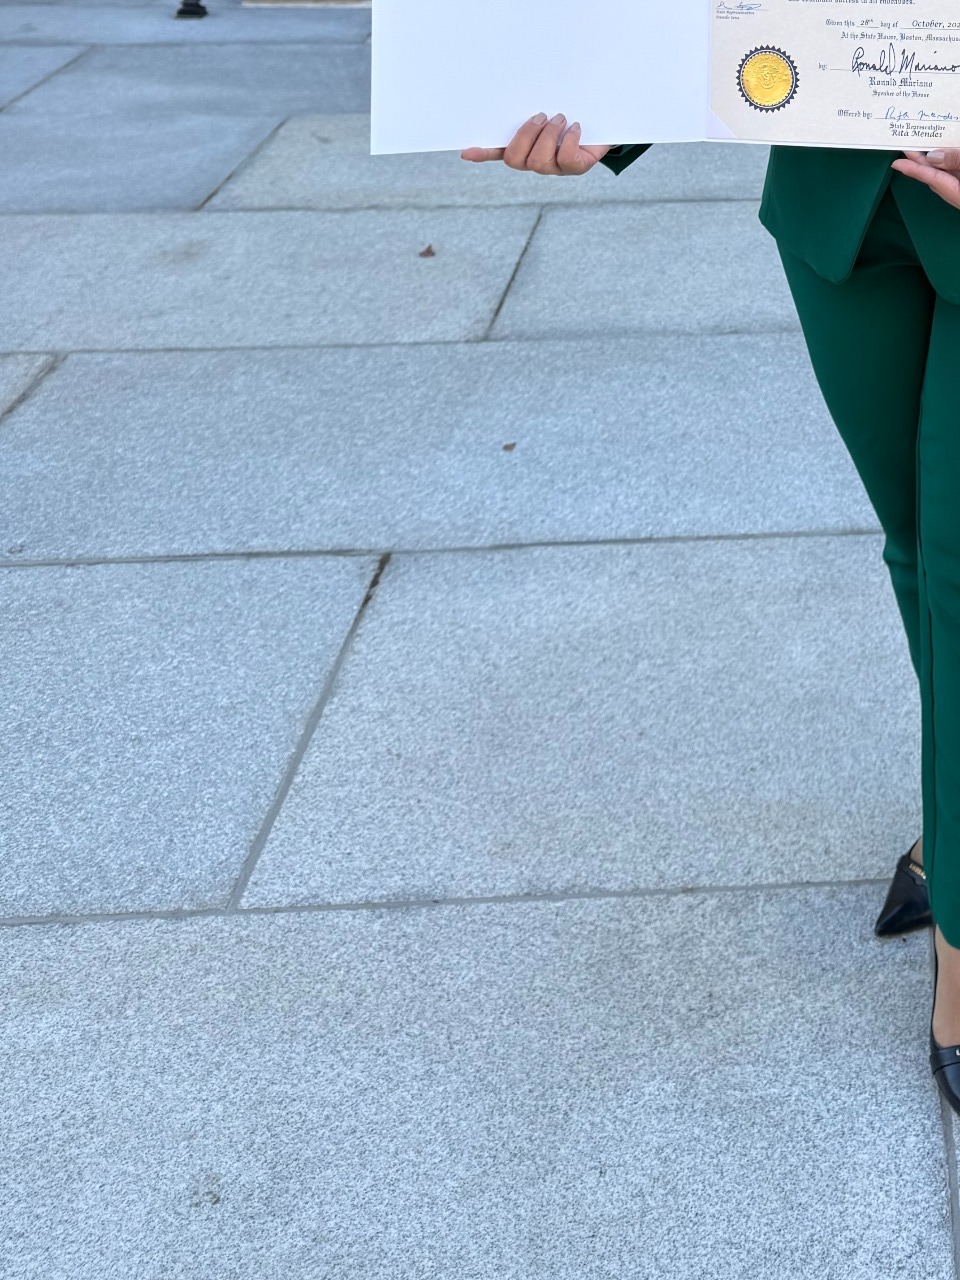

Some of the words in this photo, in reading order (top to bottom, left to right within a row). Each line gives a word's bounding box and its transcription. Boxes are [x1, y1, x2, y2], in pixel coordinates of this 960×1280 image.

[844, 19, 855, 28] this
[881, 21, 891, 29] day
[912, 19, 944, 28] October,
[859, 33, 875, 42] State
[900, 33, 923, 42] Boston,
[869, 77, 897, 87] Ronald
[898, 78, 933, 88] Mariano
[873, 89, 894, 97] Speaker
[838, 109, 861, 118] Offered
[863, 110, 873, 119] by:
[906, 123, 945, 131] Representative
